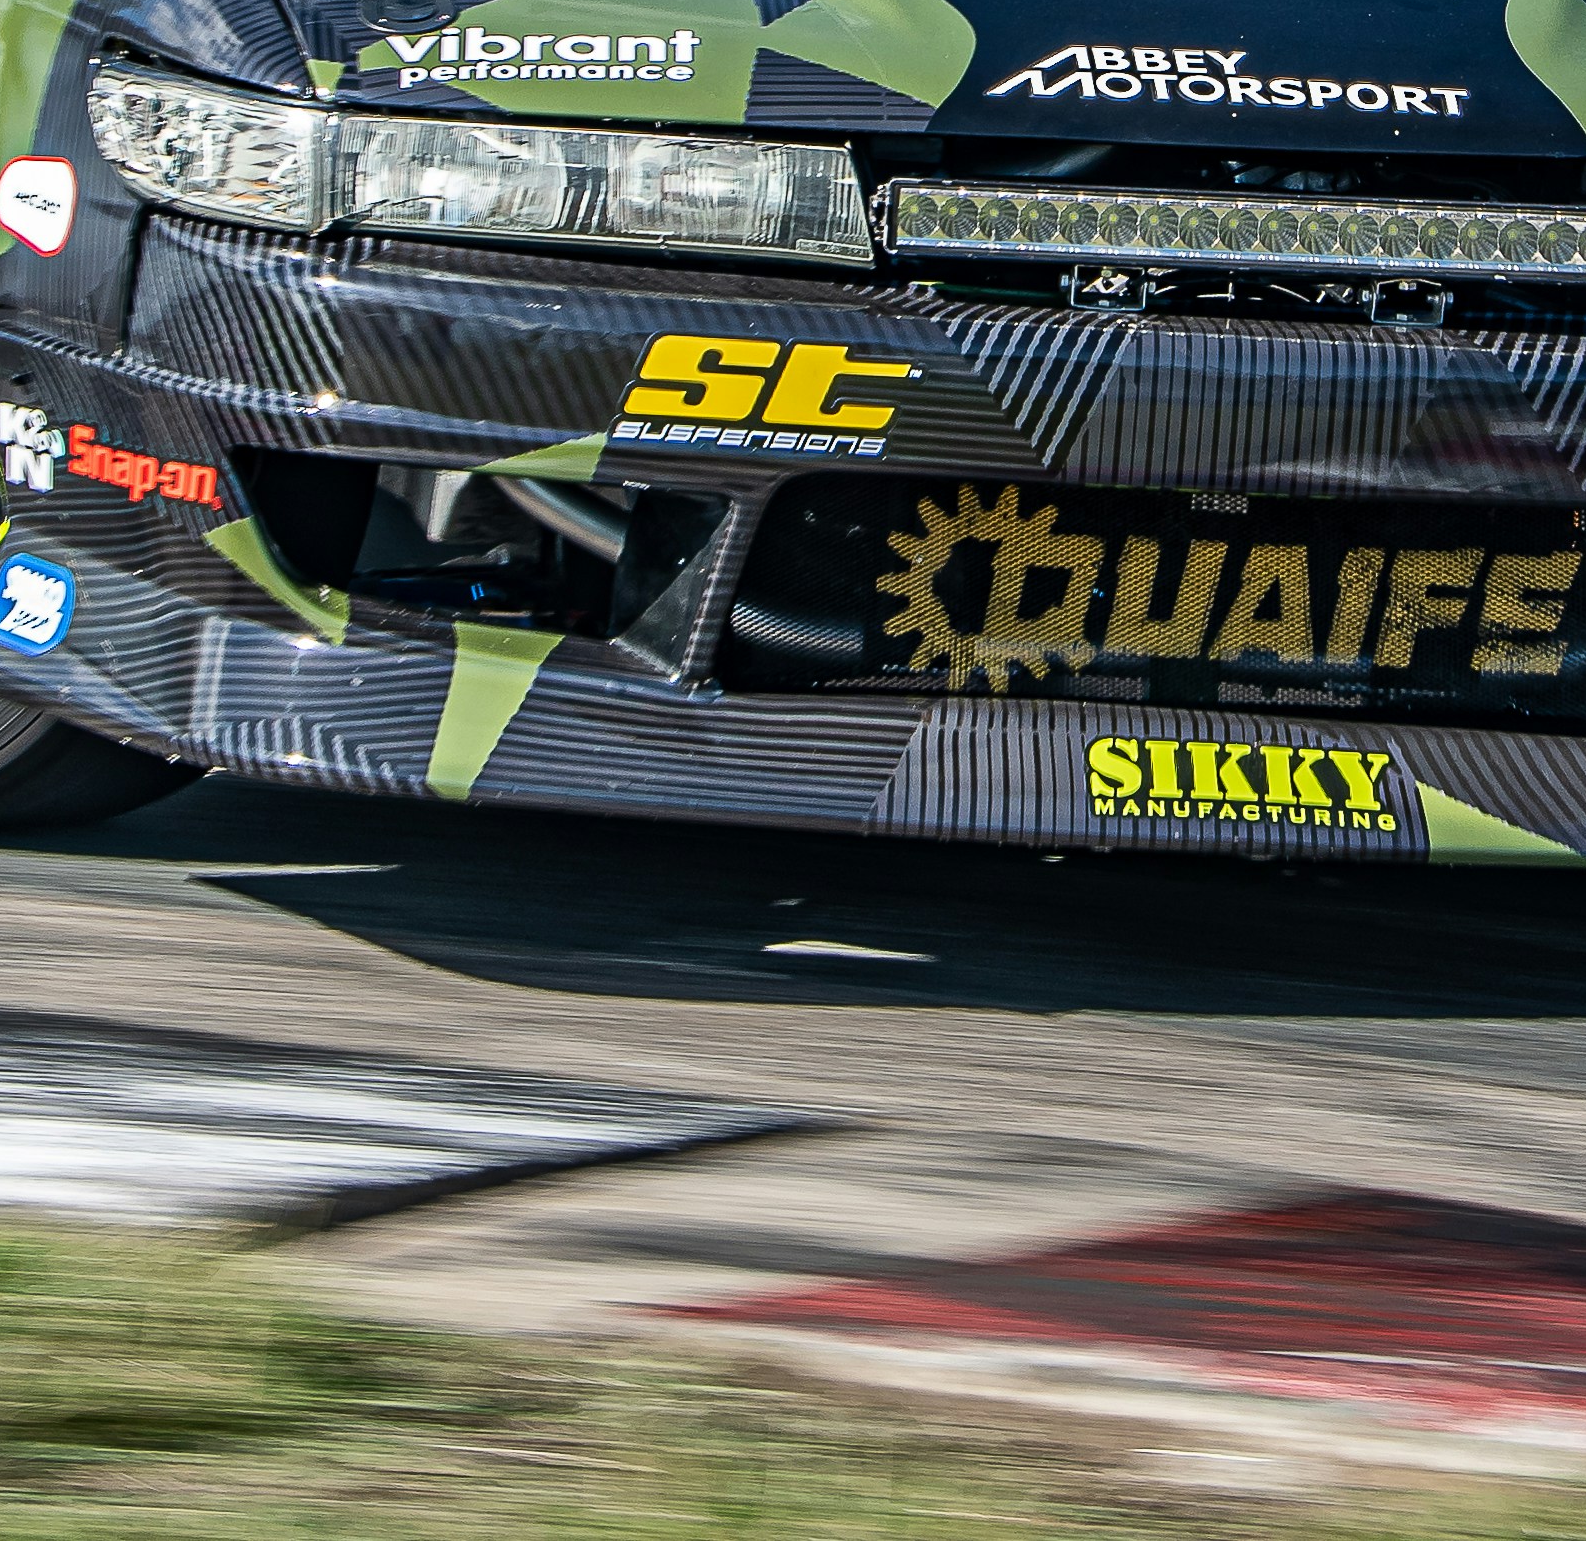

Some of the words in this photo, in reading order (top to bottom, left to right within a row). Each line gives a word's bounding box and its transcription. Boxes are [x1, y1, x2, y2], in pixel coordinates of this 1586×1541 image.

[384, 27, 702, 63] vibrant
[1029, 44, 1248, 75] ABBEY
[398, 60, 695, 90] performance
[984, 71, 1471, 118] MOTORSPORT
[68, 423, 218, 503] Snap-on
[1088, 737, 1390, 811] SIKKY
[1094, 797, 1397, 831] MANUFACTURING
